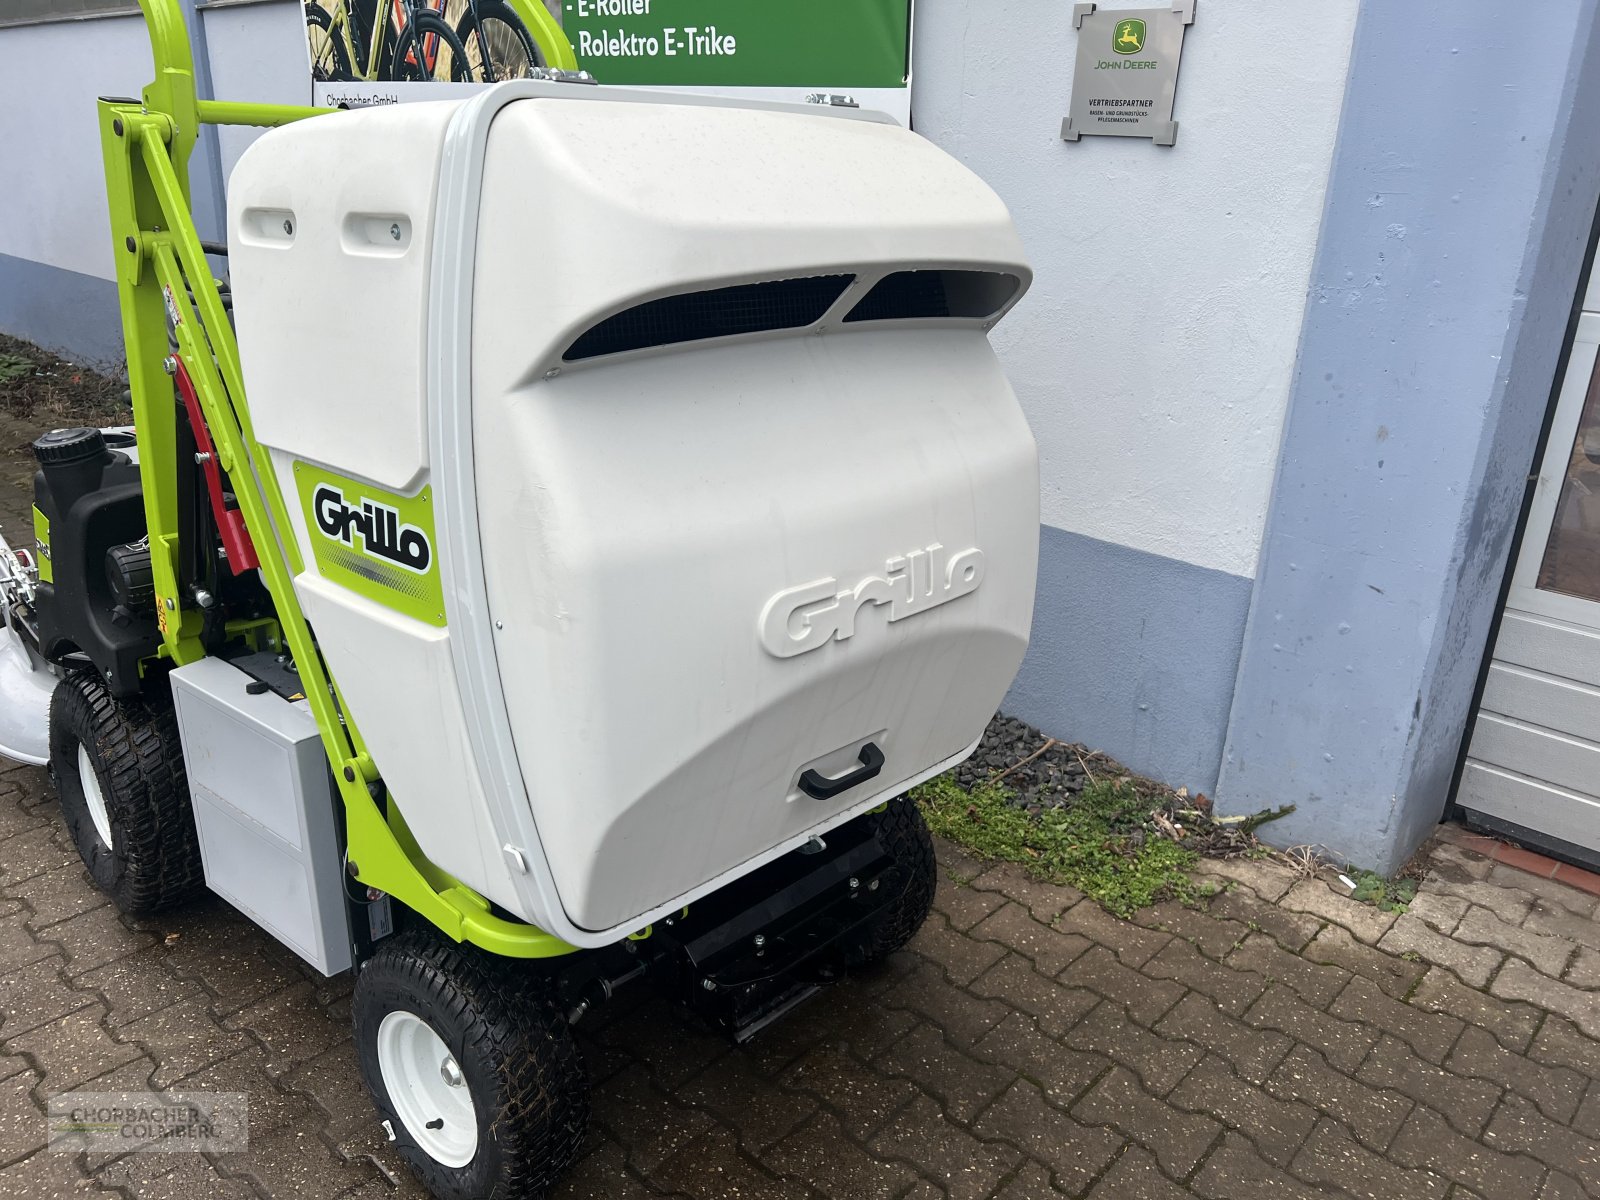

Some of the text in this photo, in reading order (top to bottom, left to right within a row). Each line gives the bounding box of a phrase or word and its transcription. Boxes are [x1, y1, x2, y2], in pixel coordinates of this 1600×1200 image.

[578, 0, 650, 17] E-Roller
[579, 26, 736, 57] Rolektro E-Trike
[1094, 60, 1158, 70] JOHN DEERE
[1088, 99, 1153, 108] VERTRIEBSPARTNER
[315, 486, 430, 571] Grillo
[757, 543, 984, 659] Grillo
